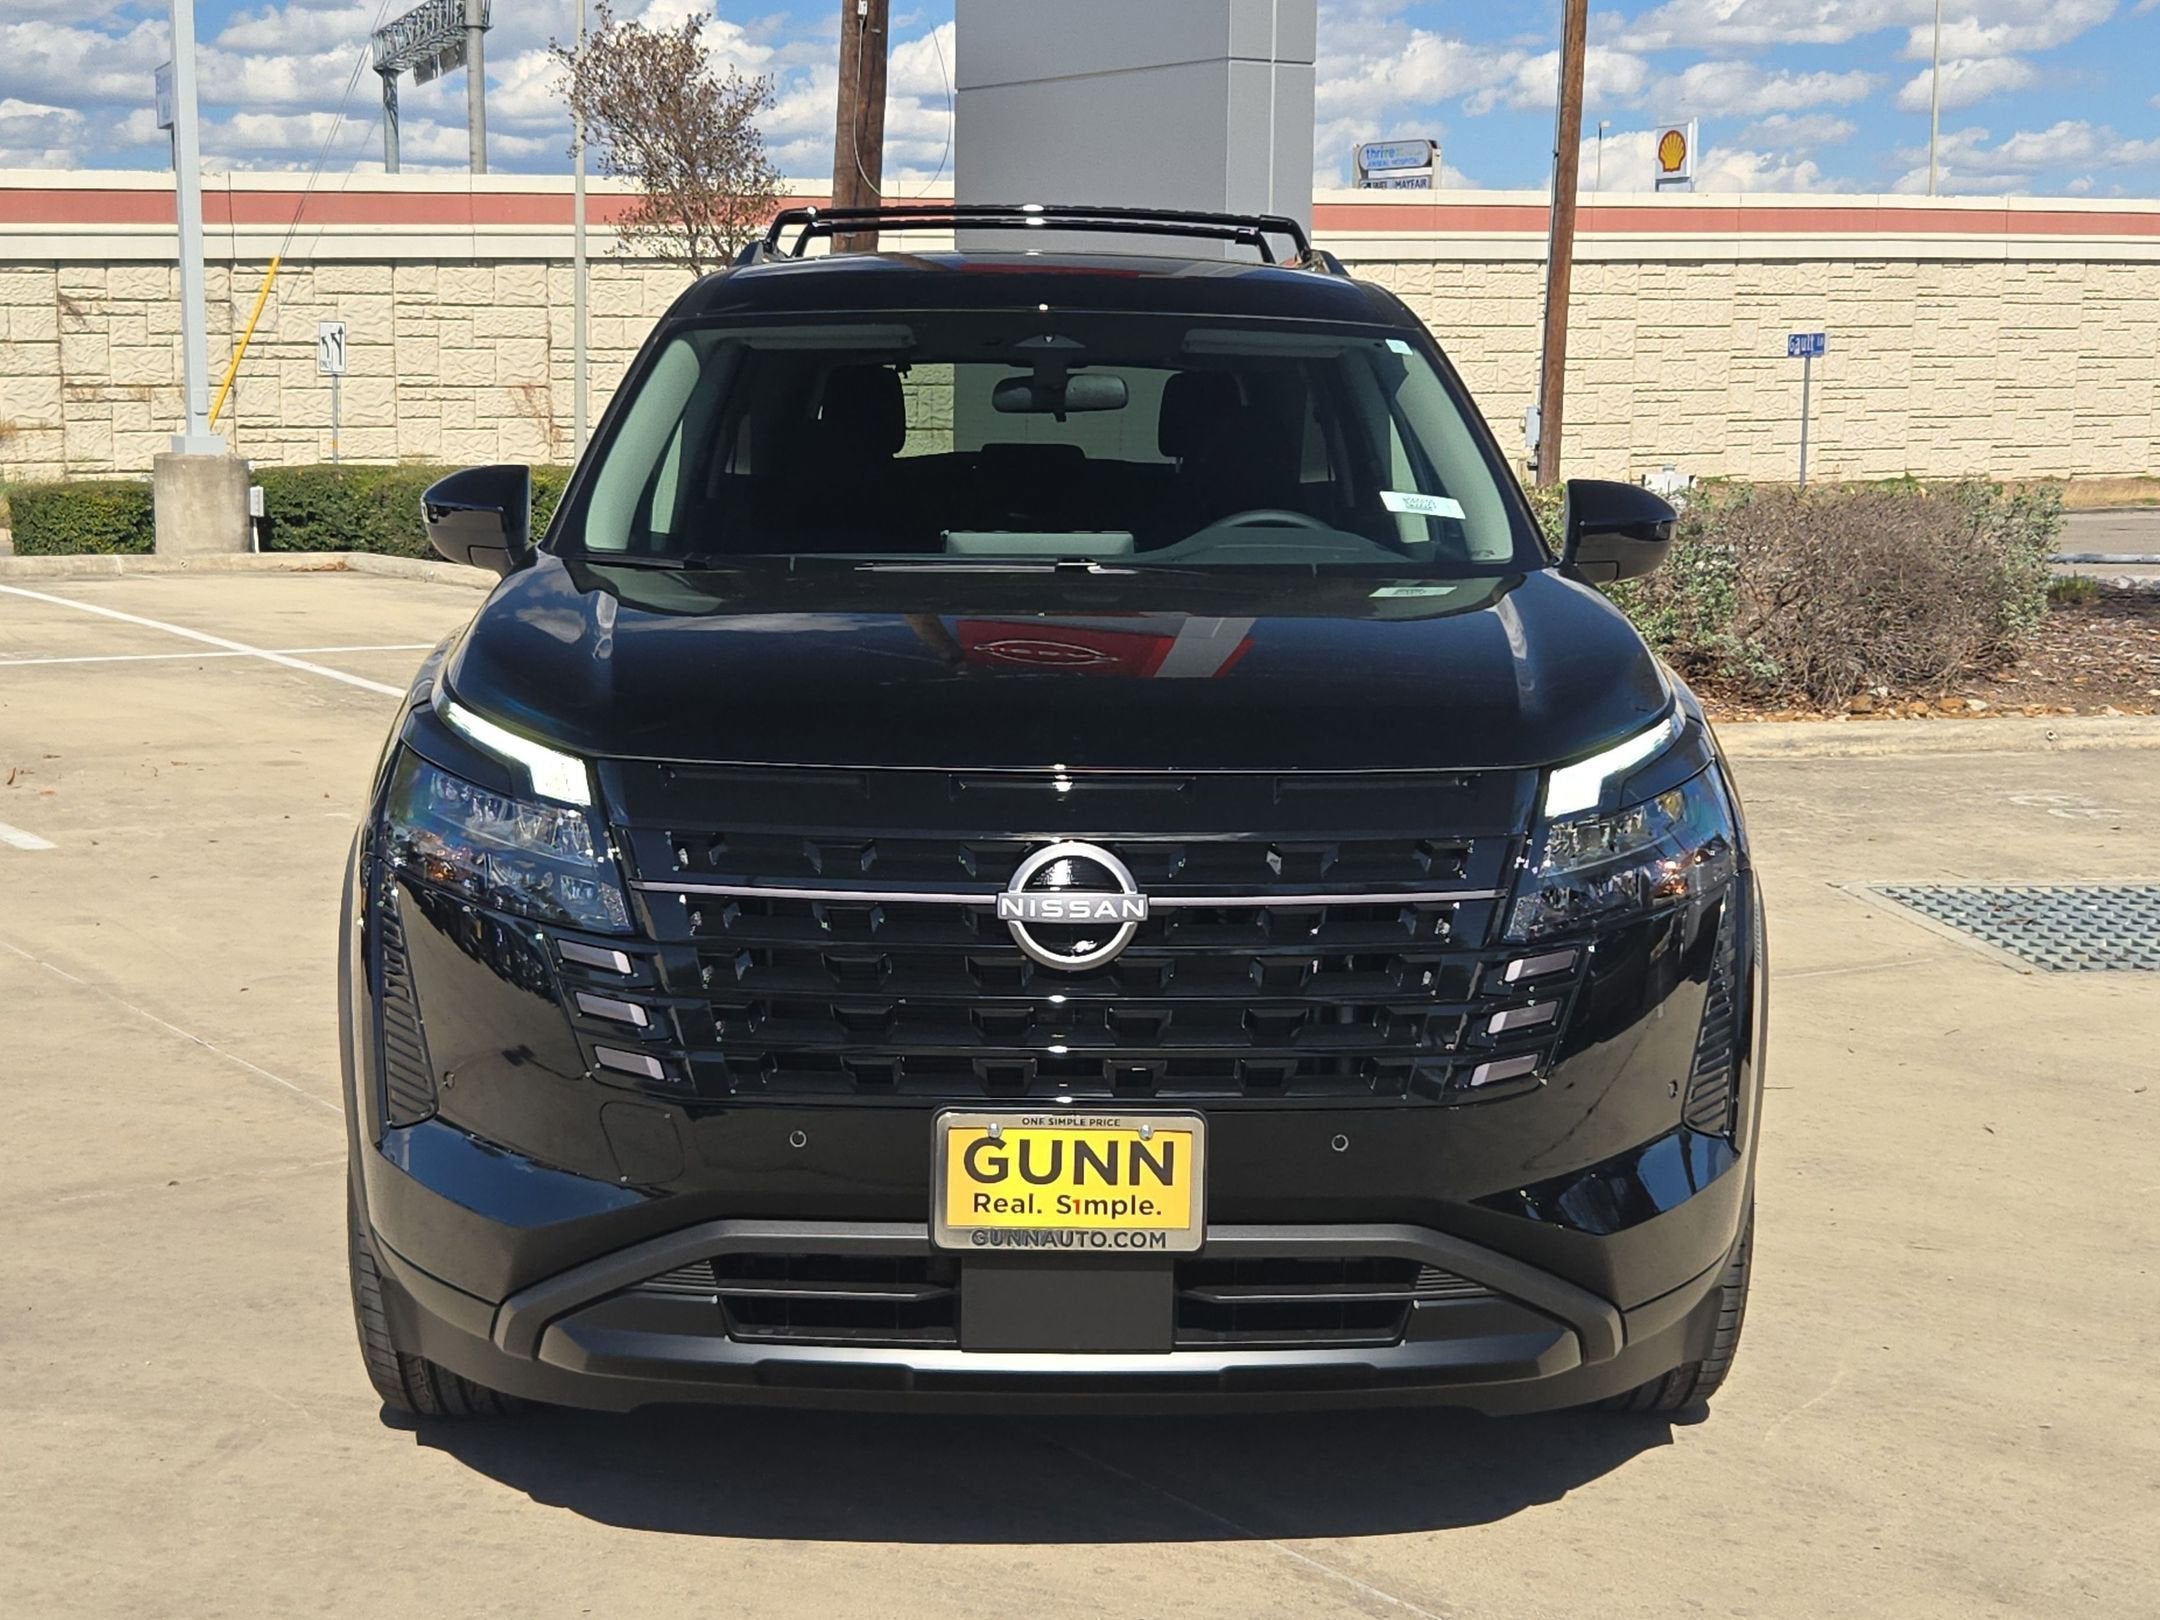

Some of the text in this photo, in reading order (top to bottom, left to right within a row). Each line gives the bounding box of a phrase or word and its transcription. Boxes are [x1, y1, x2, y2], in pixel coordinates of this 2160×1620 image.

[1789, 335, 1814, 354] Gault
[1000, 898, 1145, 918] NISSAN
[1022, 1117, 1121, 1127] ONE SIMPLE PRICE
[963, 1136, 1174, 1186] GUNN
[973, 1193, 1042, 1214] Real.
[971, 1229, 1167, 1248] GUNNAUTO.COM
